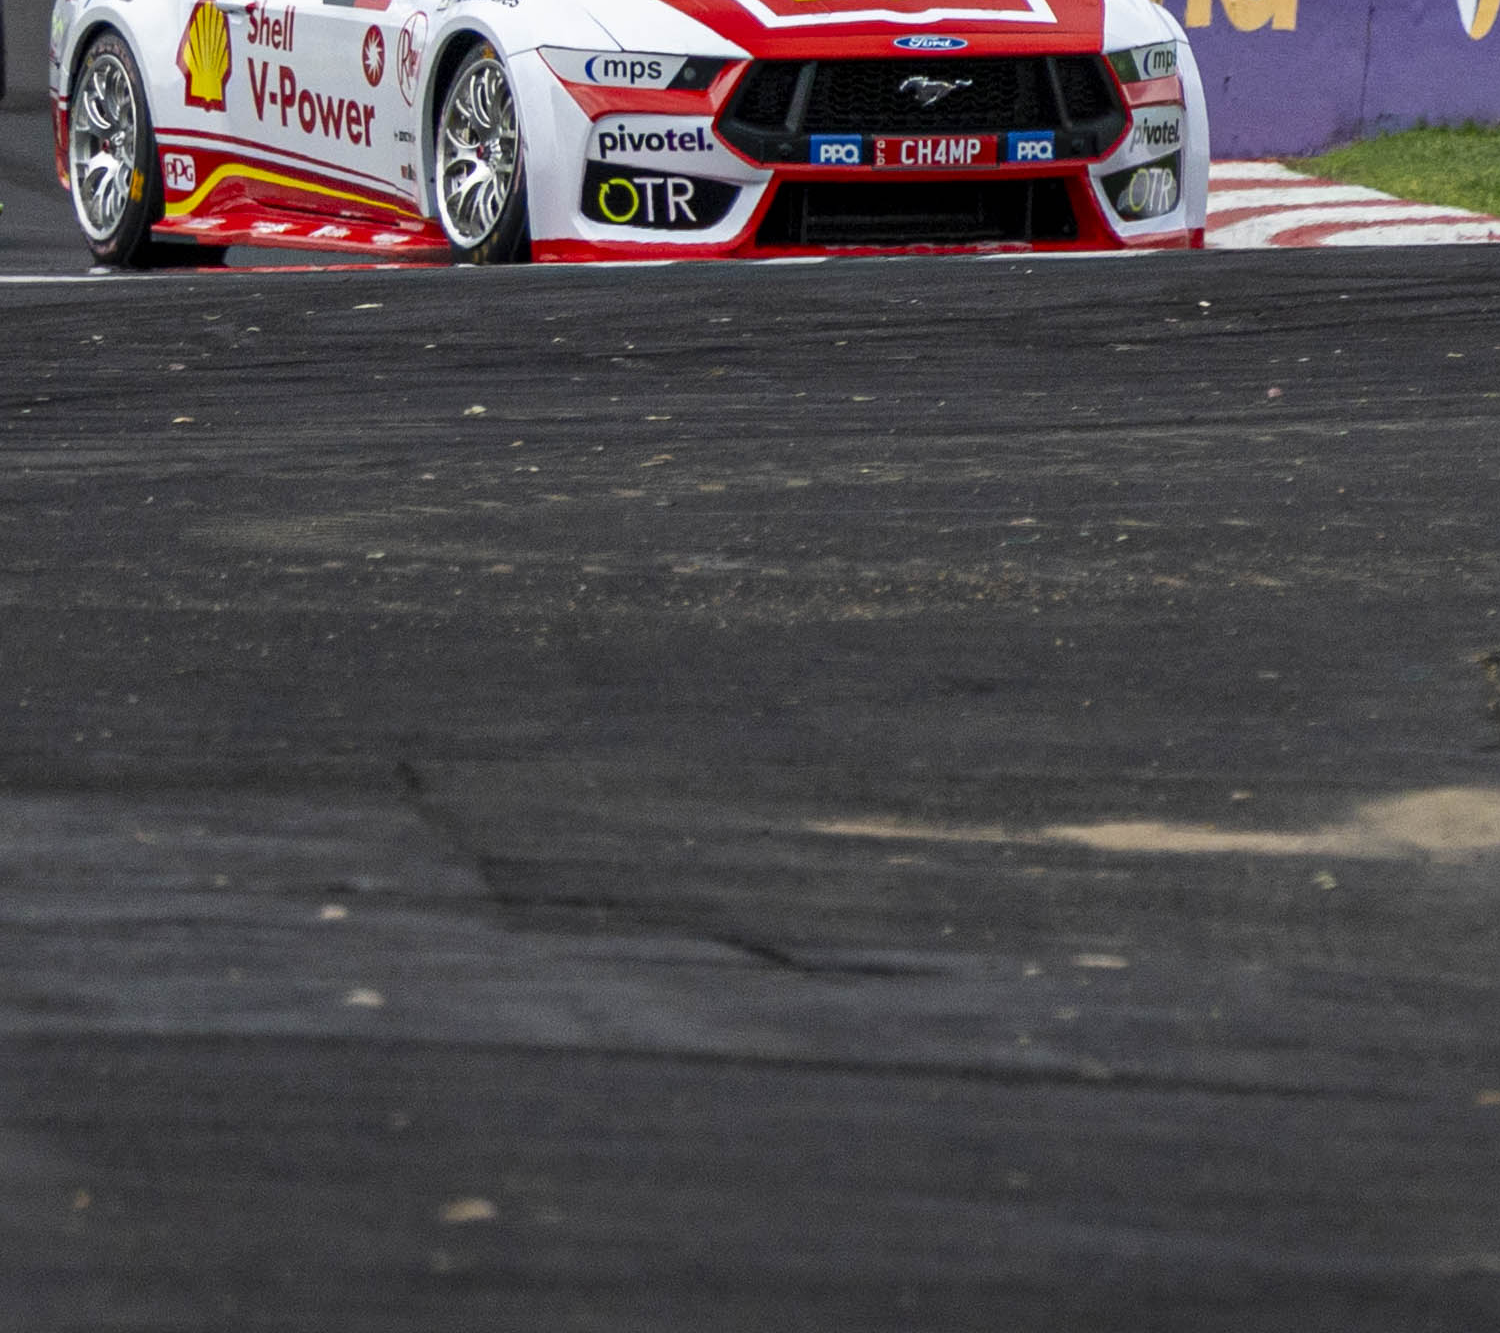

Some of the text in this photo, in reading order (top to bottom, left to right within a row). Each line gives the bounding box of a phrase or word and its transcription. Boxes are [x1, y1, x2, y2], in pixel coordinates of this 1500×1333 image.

[246, 0, 297, 53] Shell
[603, 59, 663, 85] mps
[247, 57, 377, 148] V-Power
[599, 123, 714, 159] pivotel.
[820, 142, 860, 164] PPQ
[900, 139, 981, 165] CH4MP
[1016, 140, 1053, 160] PPQ
[165, 156, 196, 187] PPG
[599, 175, 697, 223] OTR
